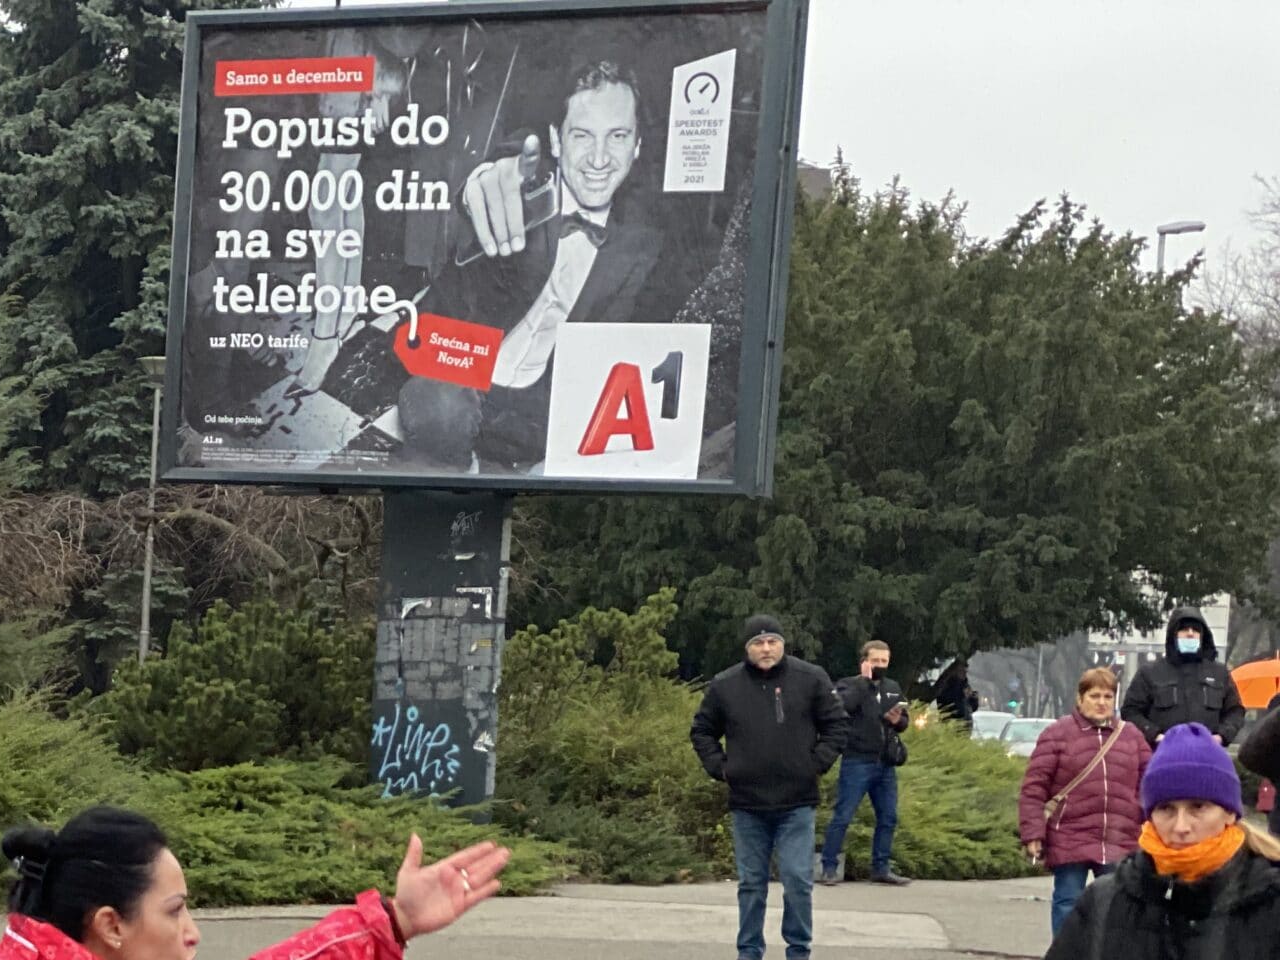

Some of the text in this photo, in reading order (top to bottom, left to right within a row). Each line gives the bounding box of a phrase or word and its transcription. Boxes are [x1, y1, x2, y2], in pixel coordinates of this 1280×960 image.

[226, 67, 363, 86] Samo u decembru
[222, 103, 450, 158] Popust do
[679, 128, 718, 136] AWARDS
[683, 175, 705, 184] 2021
[219, 169, 451, 212] 30.000 din
[215, 228, 362, 258] na sve
[213, 272, 397, 314] telefone
[209, 333, 309, 349] uz NEO tarife
[429, 332, 490, 356] Srećna mi
[204, 414, 217, 424] Od
